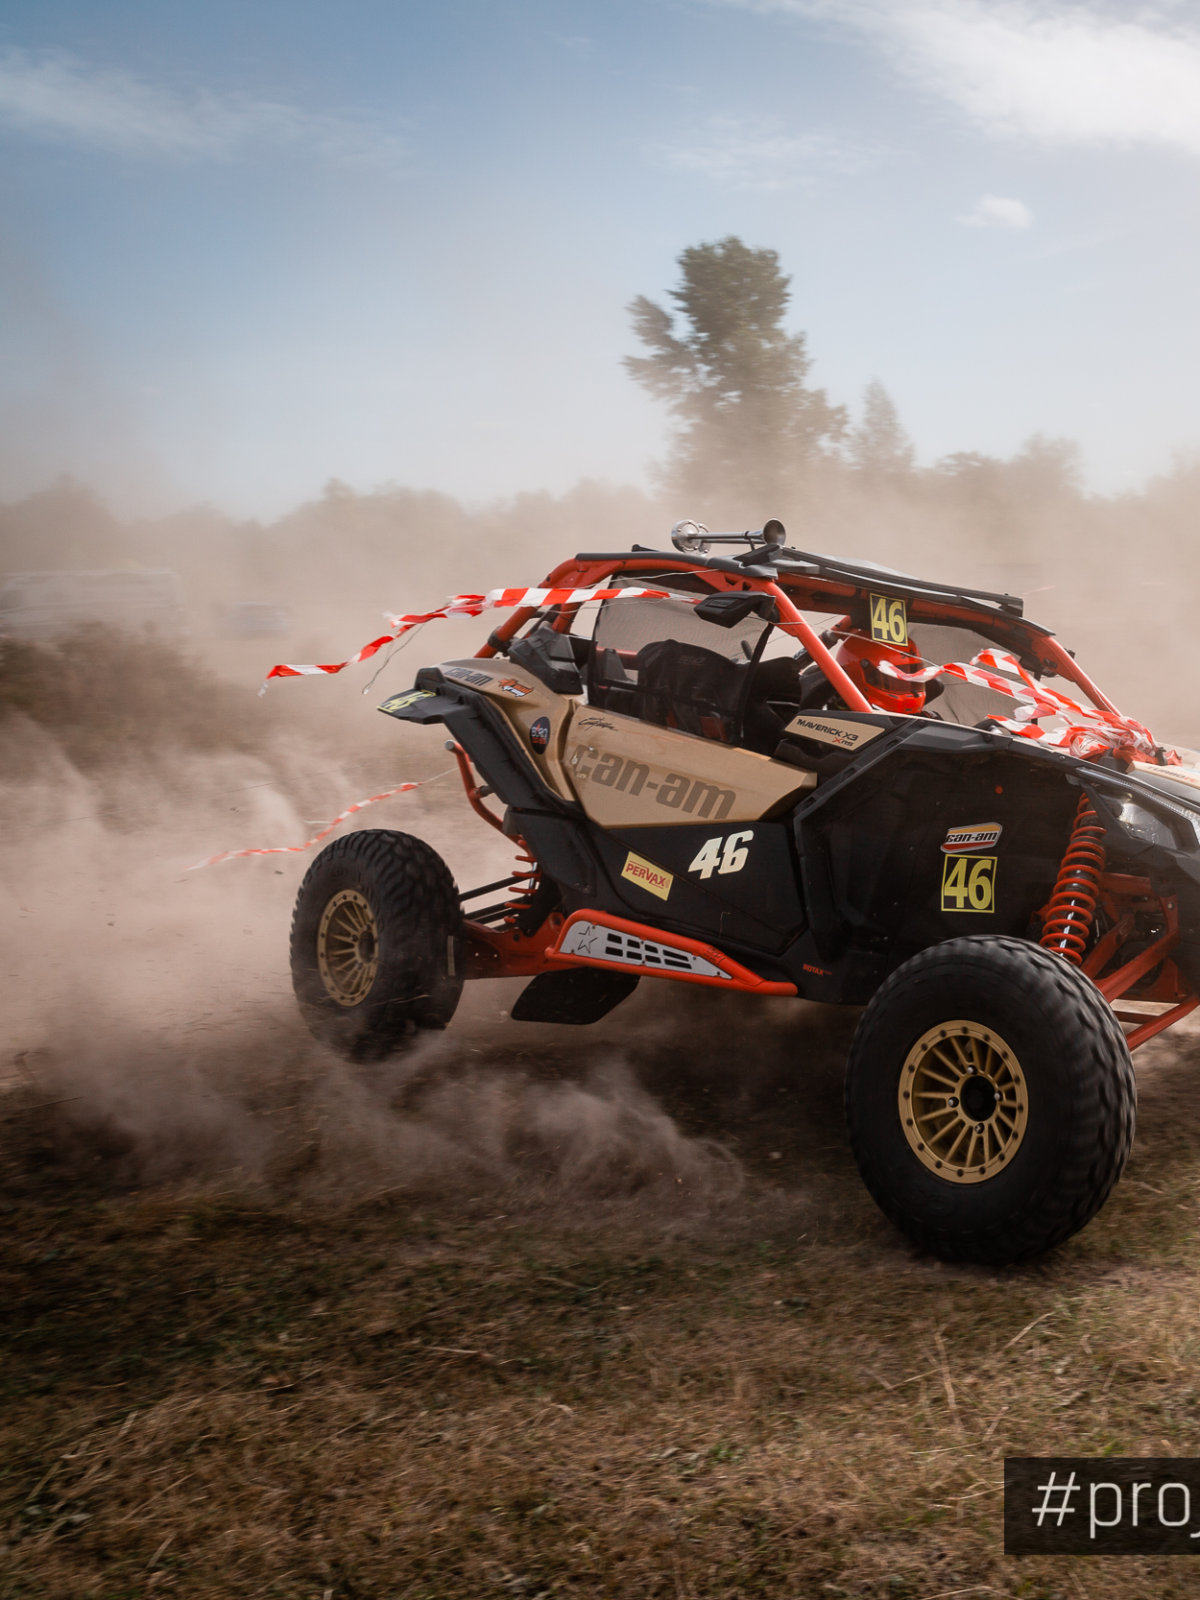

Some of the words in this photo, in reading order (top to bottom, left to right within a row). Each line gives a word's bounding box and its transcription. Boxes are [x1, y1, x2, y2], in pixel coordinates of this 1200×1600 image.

[872, 598, 905, 643] 46
[796, 718, 843, 738] MAVERICK
[842, 731, 859, 742] X3
[570, 744, 737, 820] can-am
[688, 829, 755, 880] 46
[945, 831, 998, 843] can-am
[625, 862, 666, 888] PERVAX
[943, 858, 993, 910] 46
